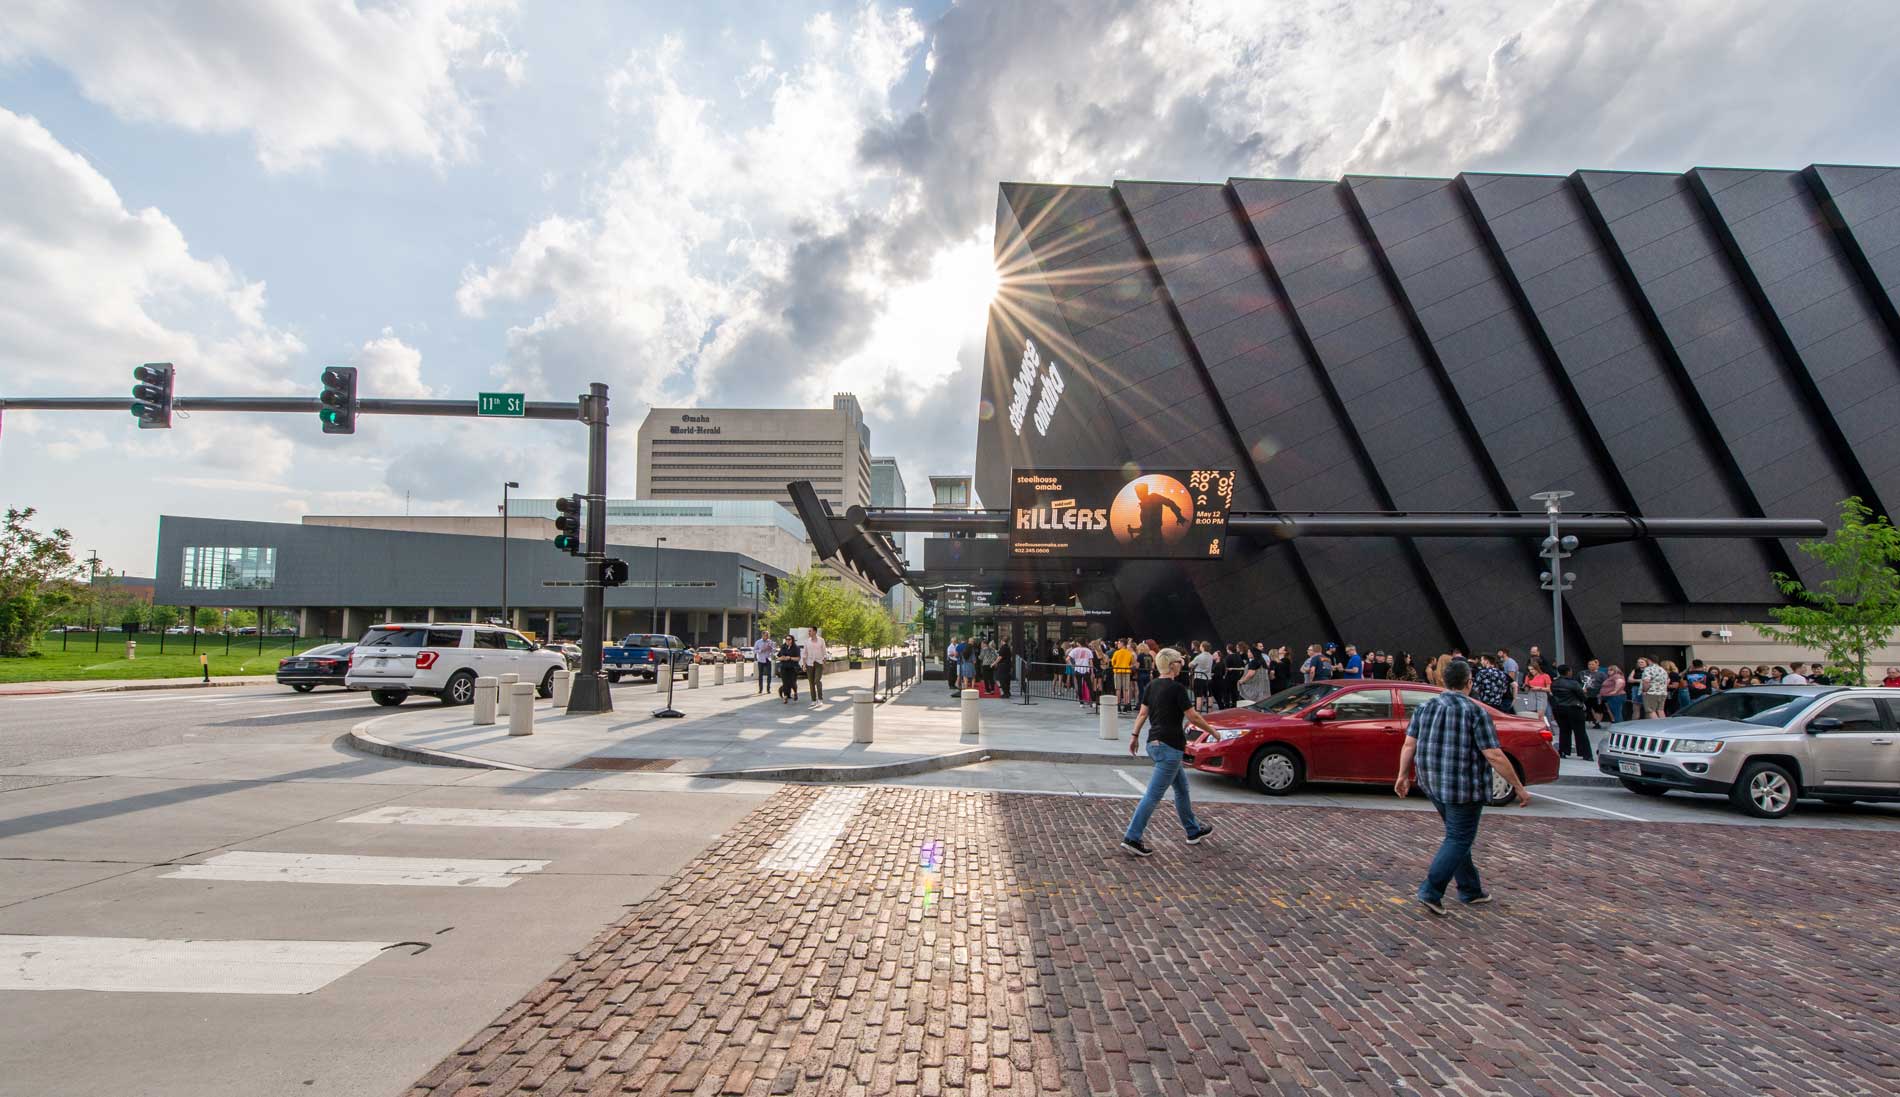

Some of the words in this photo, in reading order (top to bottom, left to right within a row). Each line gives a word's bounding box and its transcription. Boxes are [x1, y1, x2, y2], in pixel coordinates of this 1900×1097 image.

[482, 397, 501, 410] 11th
[507, 397, 520, 411] St
[681, 414, 710, 422] Omaha
[670, 425, 721, 434] World-Herald
[1017, 475, 1057, 483] steelhouse
[1035, 483, 1062, 491] omaha
